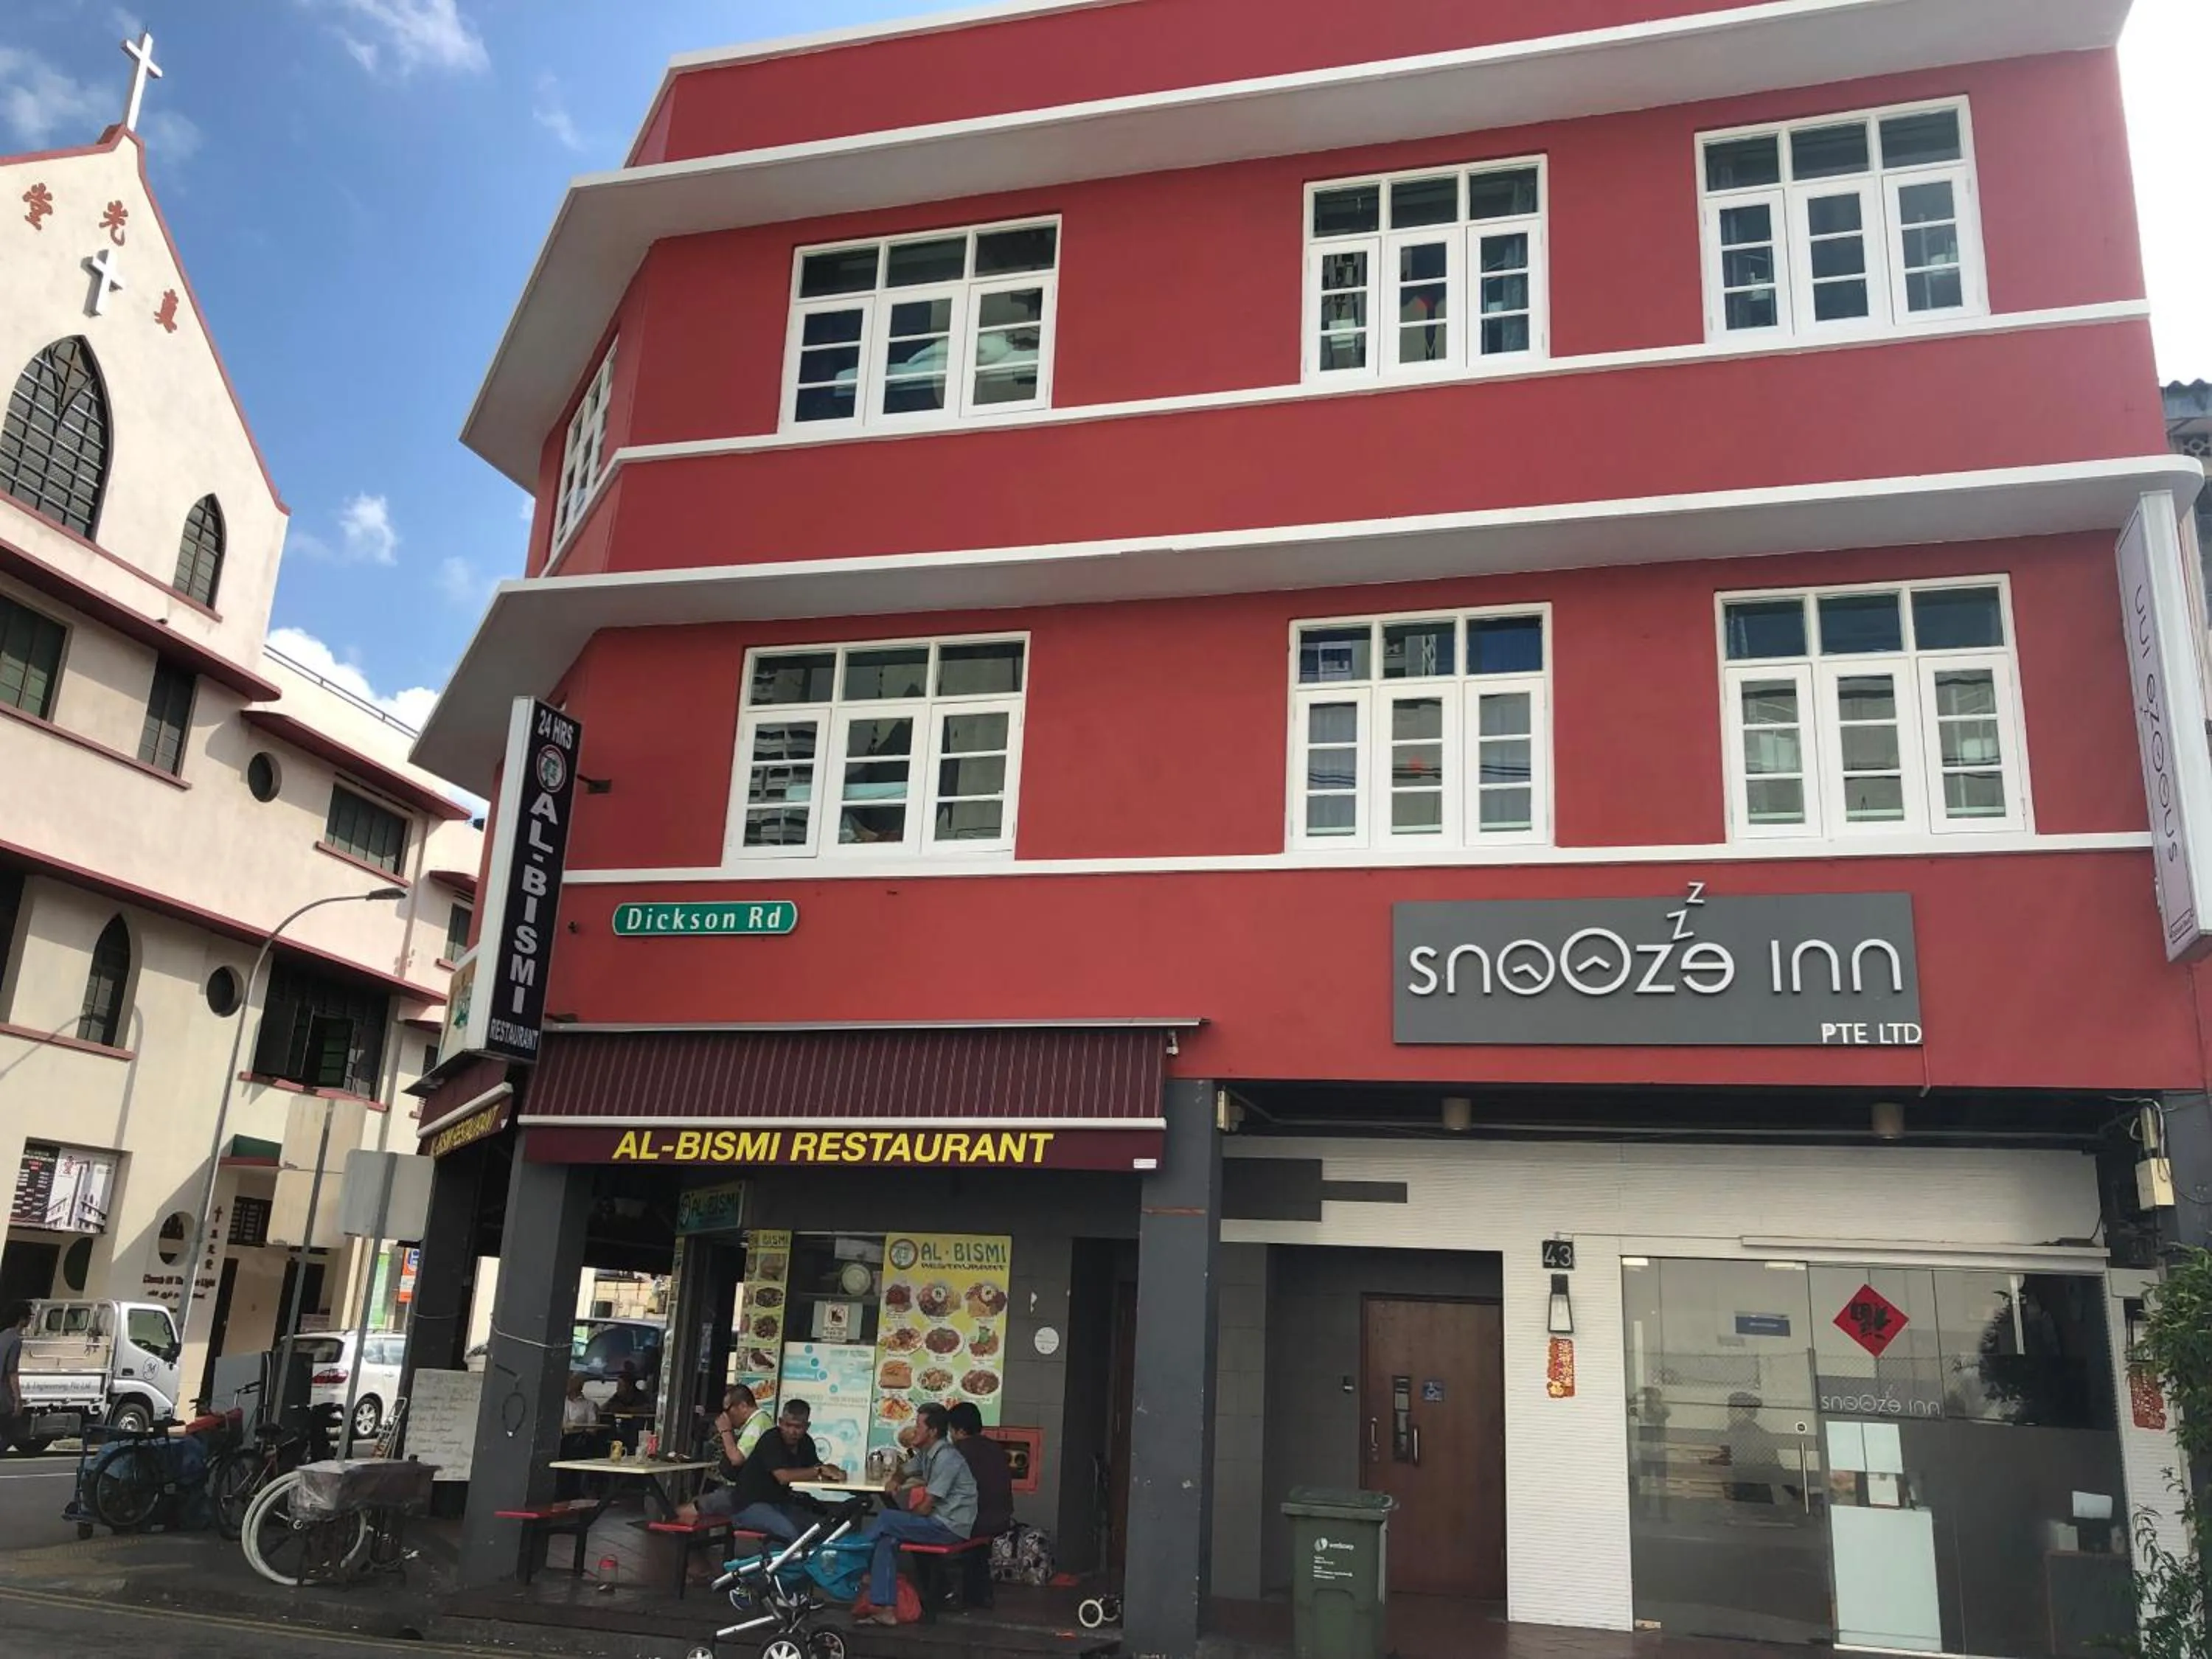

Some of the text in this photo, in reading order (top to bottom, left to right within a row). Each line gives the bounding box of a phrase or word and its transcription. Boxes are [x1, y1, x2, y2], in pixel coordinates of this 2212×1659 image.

[538, 709, 575, 751] 24 HRS
[510, 794, 559, 1014] AL-BISMI
[626, 906, 782, 931] Dickson Rd
[488, 1020, 540, 1050] RESTAURANT
[1820, 1023, 1923, 1045] PTE LTD
[612, 1131, 1054, 1162] AL-BISMI RESTAURANT
[921, 1242, 1007, 1264] AL BISMI
[1544, 1244, 1572, 1267] 43
